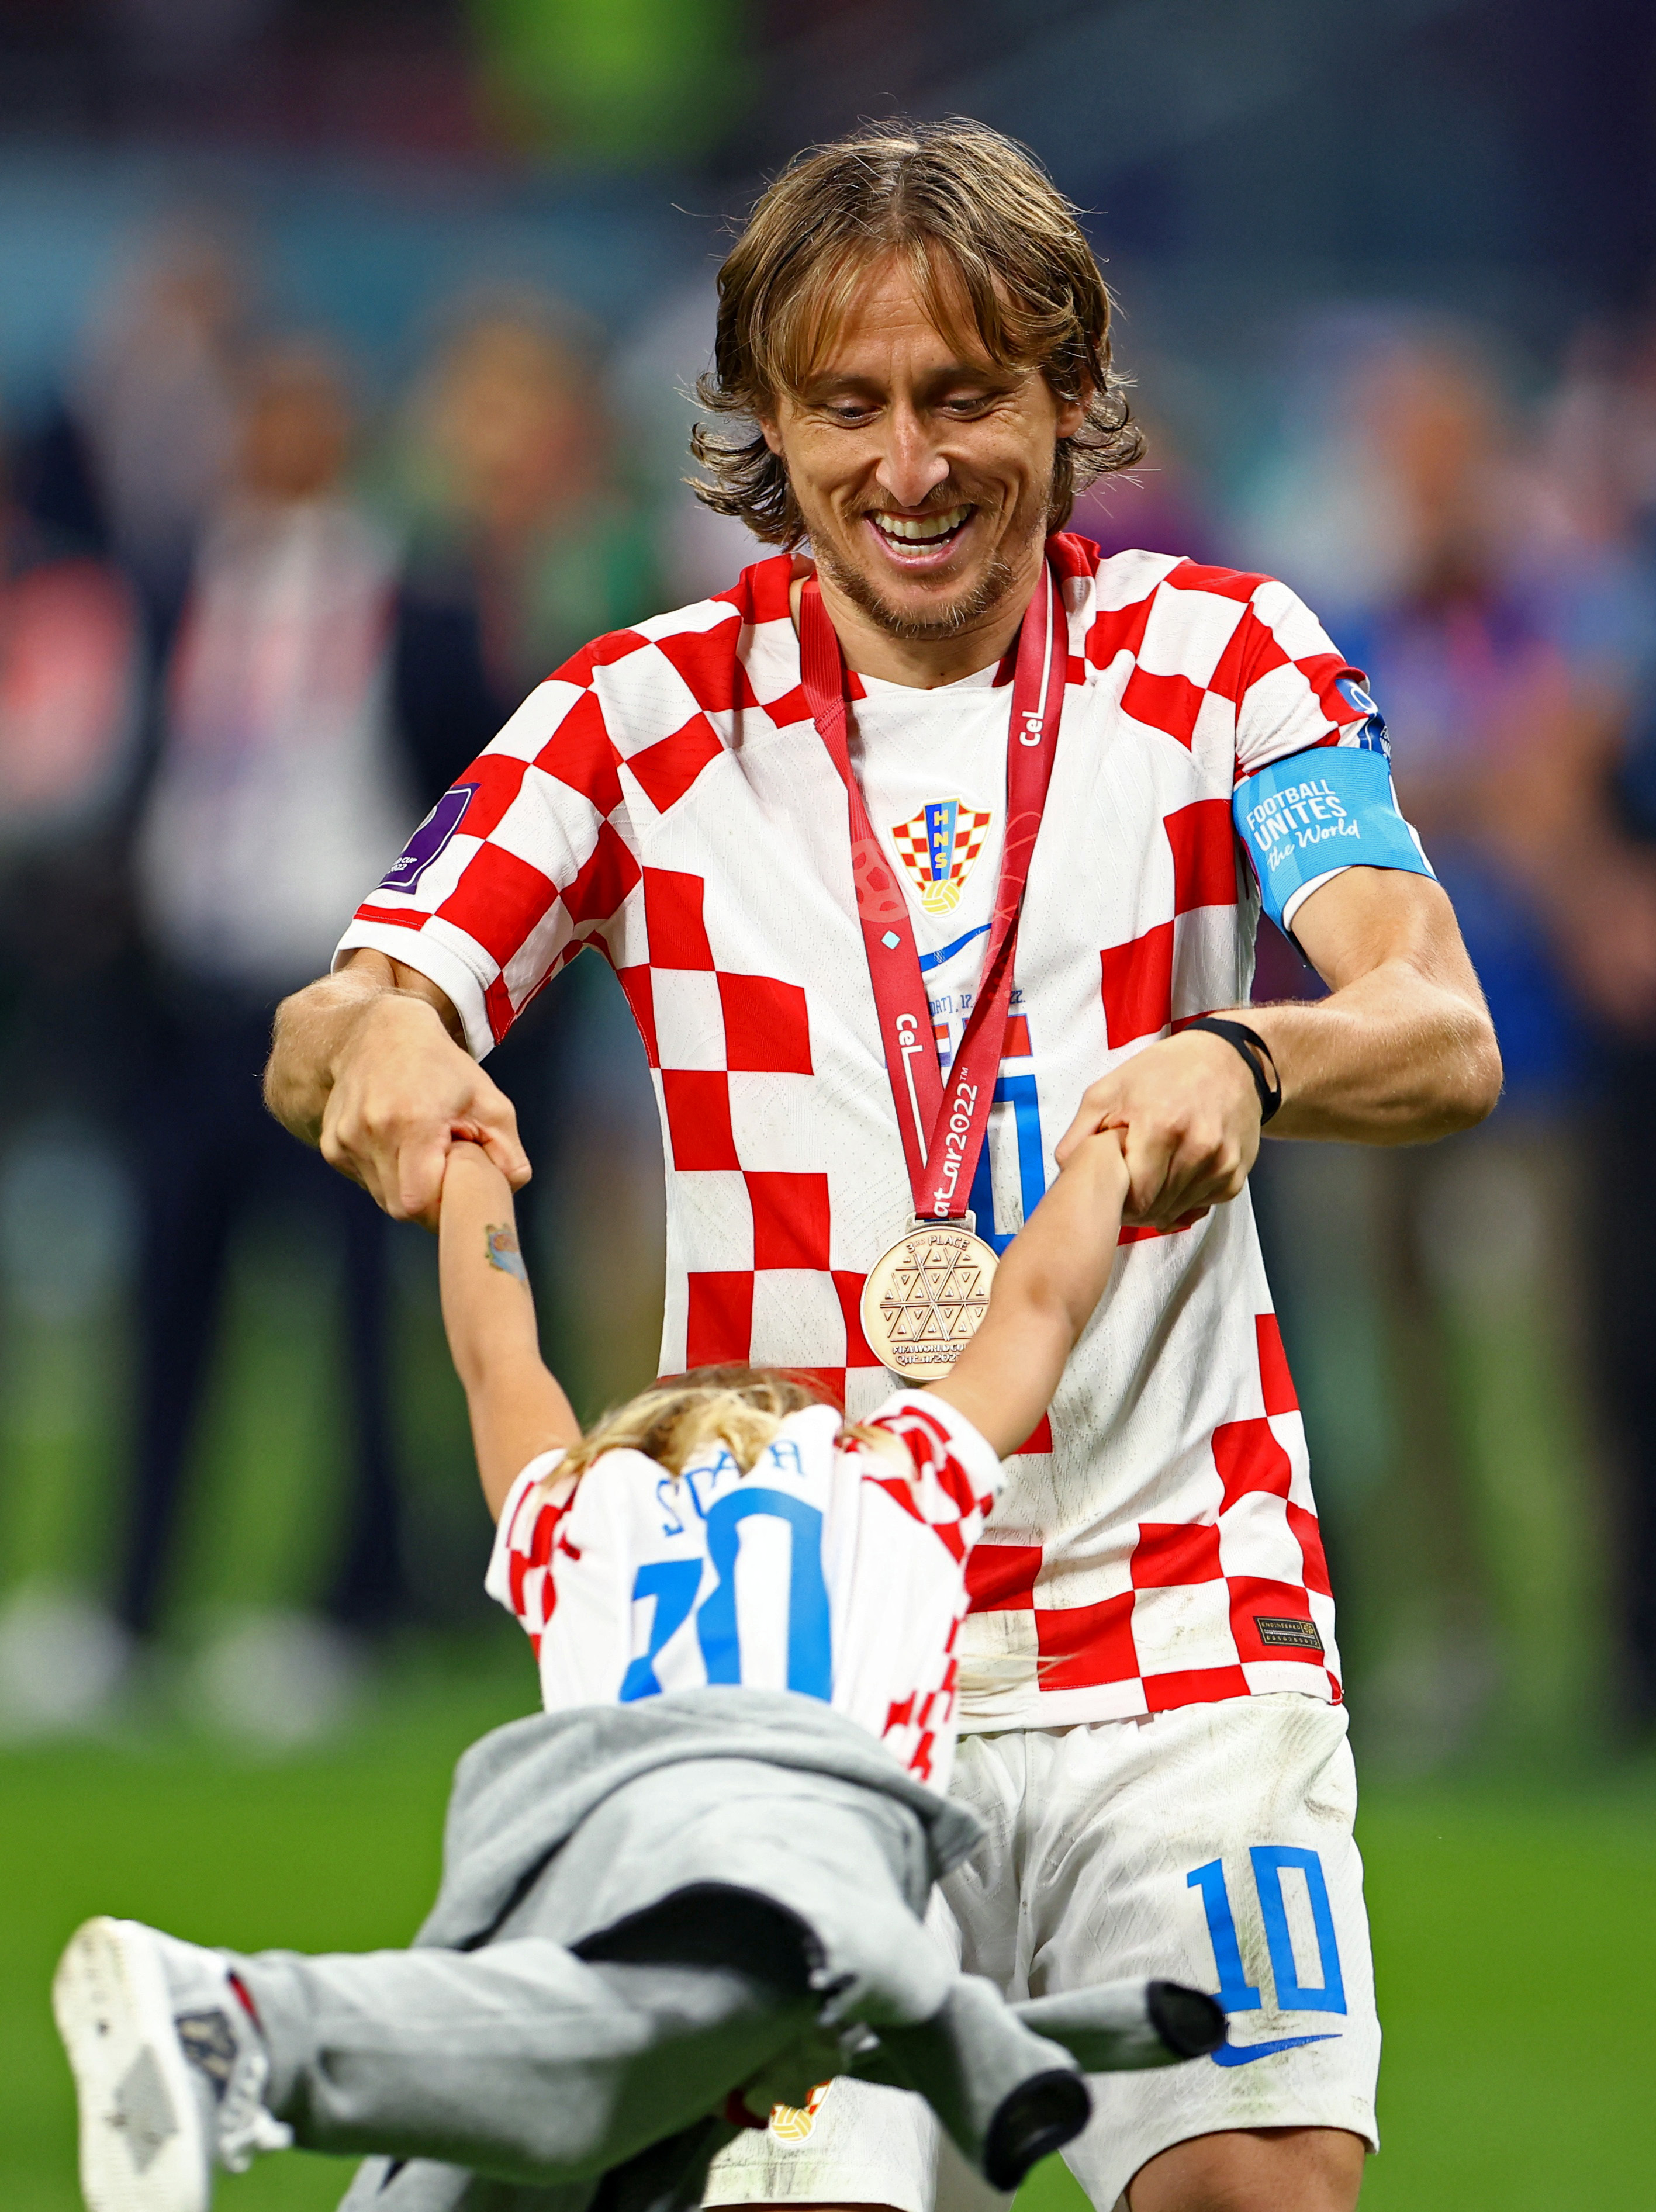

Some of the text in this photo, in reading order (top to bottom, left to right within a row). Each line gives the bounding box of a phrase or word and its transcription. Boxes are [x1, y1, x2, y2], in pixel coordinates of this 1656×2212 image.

[1246, 779, 1336, 831] FOOTBALL
[1253, 795, 1347, 851] UNITES
[934, 810, 948, 869] HNS
[1266, 819, 1361, 872] the World
[928, 1235, 970, 1251] PLACE
[893, 1344, 966, 1355] FIFA WORLD CU
[896, 1353, 959, 1366] Qatar202
[1186, 1845, 1347, 2016] 10
